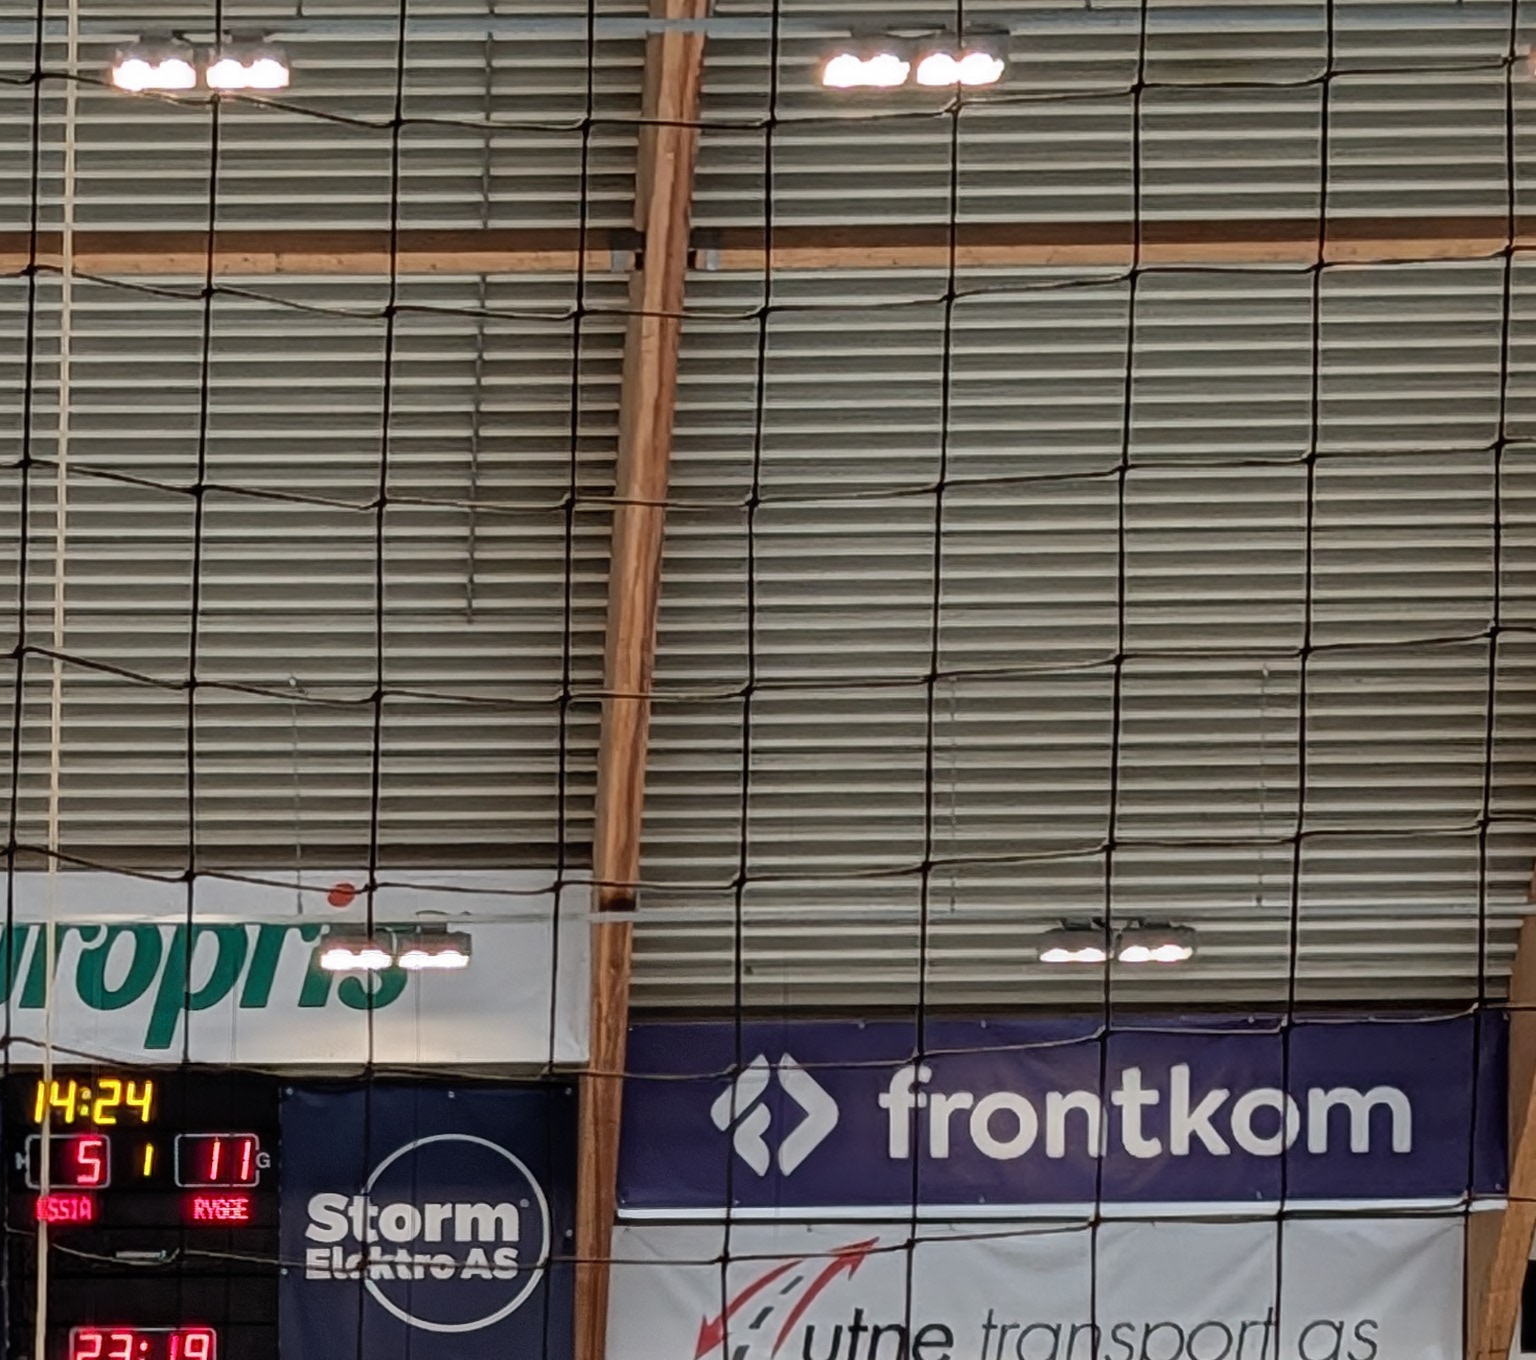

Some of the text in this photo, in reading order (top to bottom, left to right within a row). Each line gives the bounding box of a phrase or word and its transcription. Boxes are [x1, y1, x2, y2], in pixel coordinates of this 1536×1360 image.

[34, 1079, 153, 1124] 14:24
[878, 1060, 1412, 1162] frontkom
[77, 1140, 103, 1183] 5
[143, 1143, 154, 1176] 1
[210, 1139, 252, 1181] 11
[255, 1152, 271, 1169] G
[304, 1192, 520, 1243] Storm
[305, 1246, 520, 1280] Elektro AS
